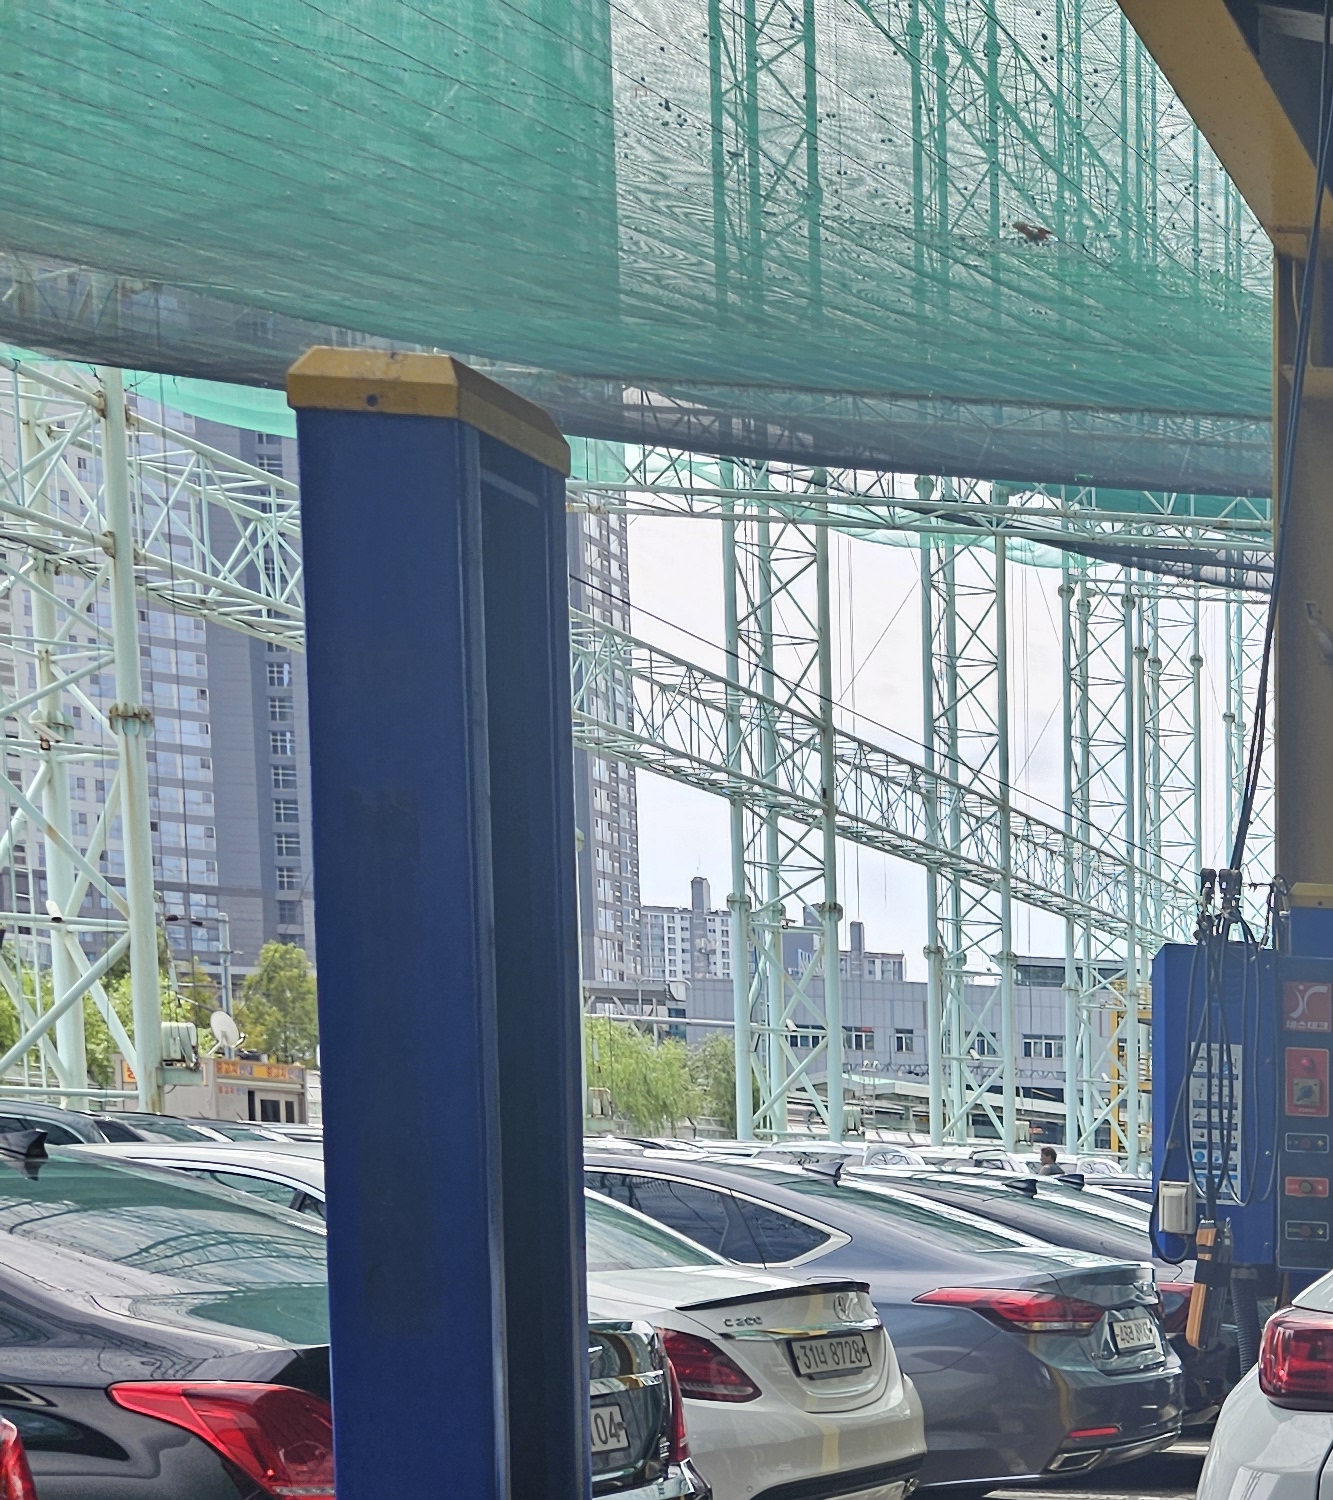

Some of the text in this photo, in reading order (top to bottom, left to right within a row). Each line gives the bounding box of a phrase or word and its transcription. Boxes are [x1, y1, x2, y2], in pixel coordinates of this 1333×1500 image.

[723, 1317, 734, 1327] C
[799, 1339, 863, 1369] 31너 8728
[591, 1411, 621, 1446] 04
